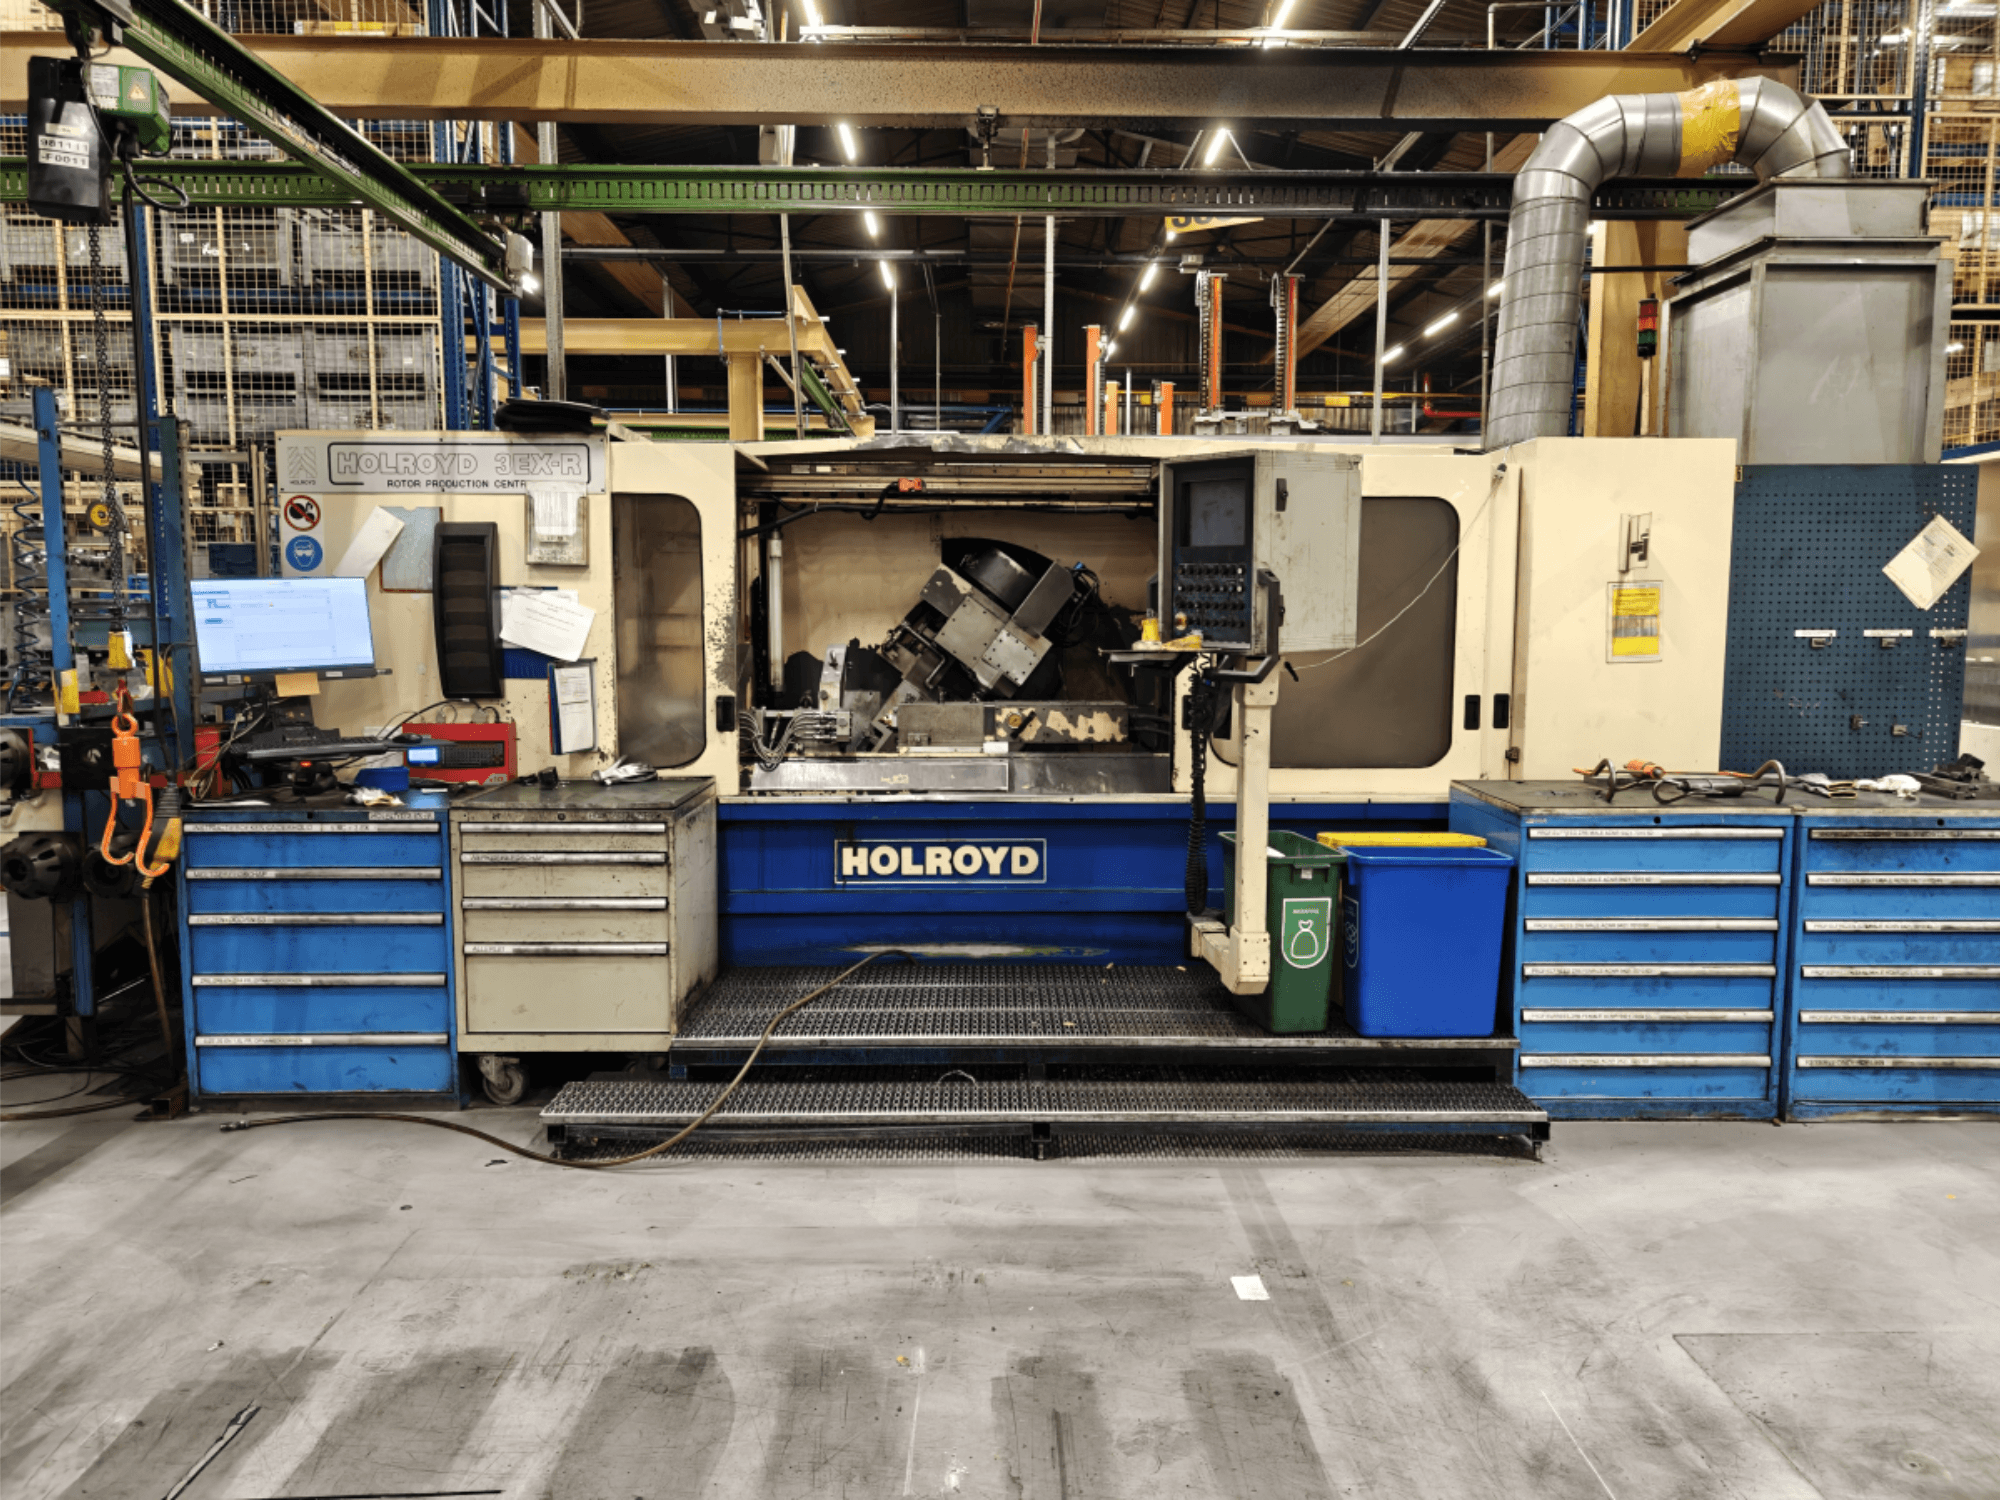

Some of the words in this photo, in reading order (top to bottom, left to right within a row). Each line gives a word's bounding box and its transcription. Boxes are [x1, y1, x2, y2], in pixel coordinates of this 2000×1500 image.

[336, 451, 478, 475] HOLROYD
[494, 452, 582, 475] 3EX-R
[387, 479, 421, 488] ROTOR
[425, 479, 489, 488] PRODUCTION
[493, 479, 526, 489] CENTR
[841, 844, 1040, 877] HOLROYD
